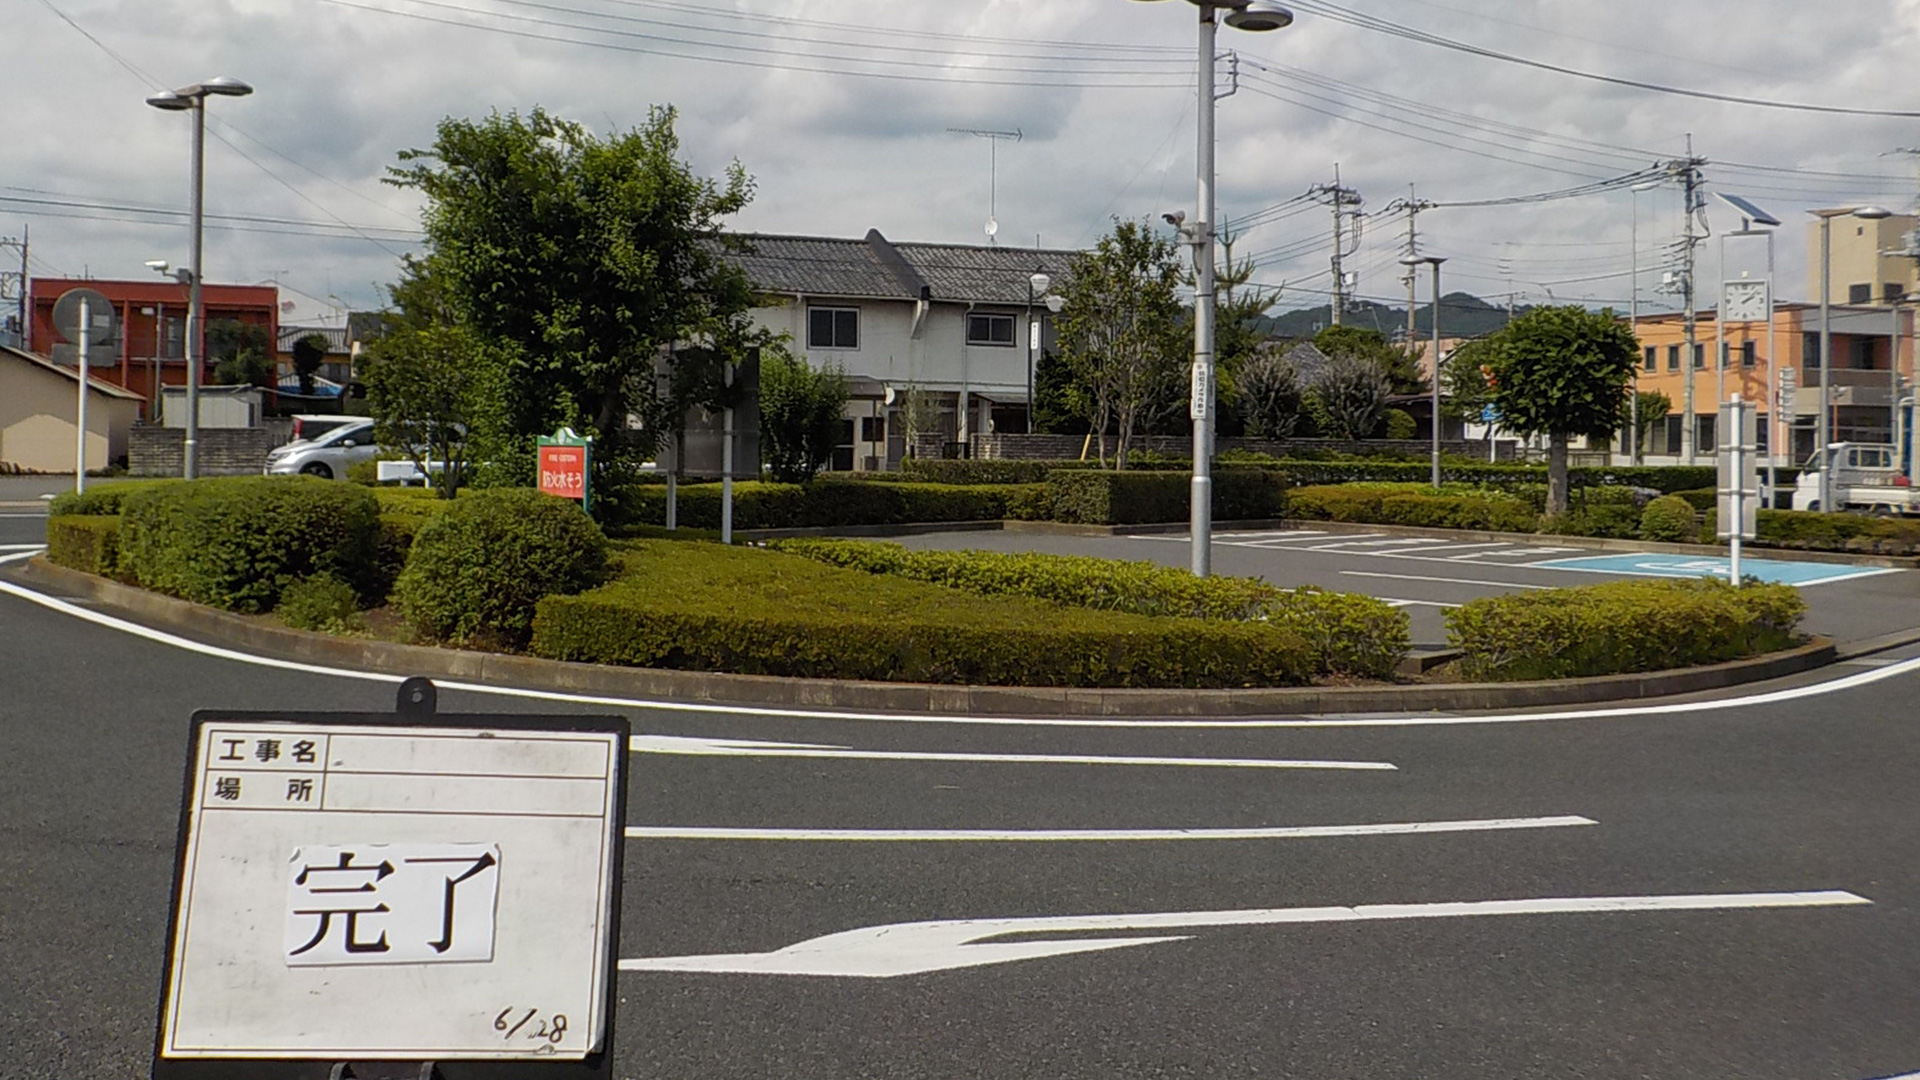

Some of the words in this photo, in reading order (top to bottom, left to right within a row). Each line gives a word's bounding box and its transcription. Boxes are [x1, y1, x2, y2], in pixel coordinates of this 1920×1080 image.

[219, 739, 316, 763] 工事名
[215, 777, 313, 801] 場所
[289, 852, 496, 957] 完了
